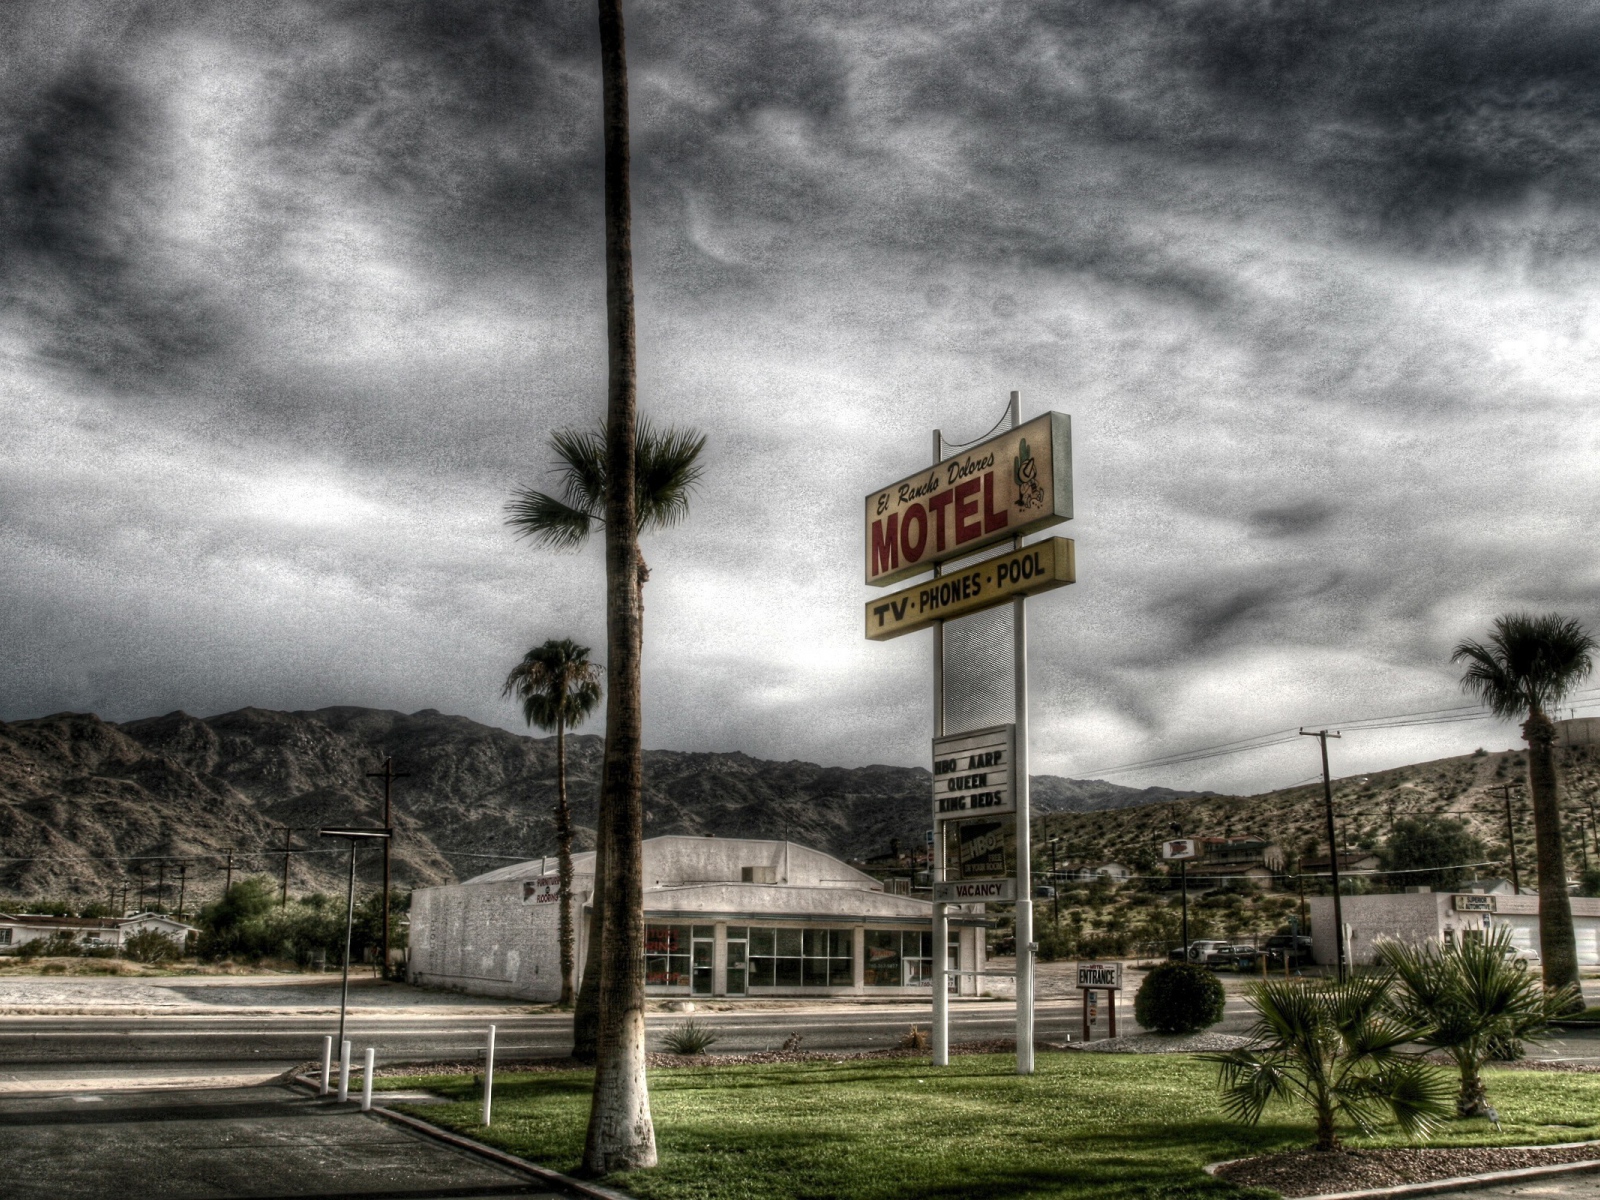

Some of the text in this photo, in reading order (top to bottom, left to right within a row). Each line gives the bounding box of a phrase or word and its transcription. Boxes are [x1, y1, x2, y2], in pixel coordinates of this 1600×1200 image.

[877, 452, 995, 515] El Rancho Dolores
[871, 471, 1009, 577] MOTEL
[873, 552, 1045, 627] TV PHONES POOL
[935, 750, 1002, 775] HBO AARP
[948, 774, 987, 792] QUEEN
[939, 790, 1002, 813] KING BEDS
[969, 833, 996, 859] HBO
[537, 893, 559, 903] FLOORING
[956, 884, 1002, 897] VACANCY
[1079, 969, 1115, 984] ENTRANCE
